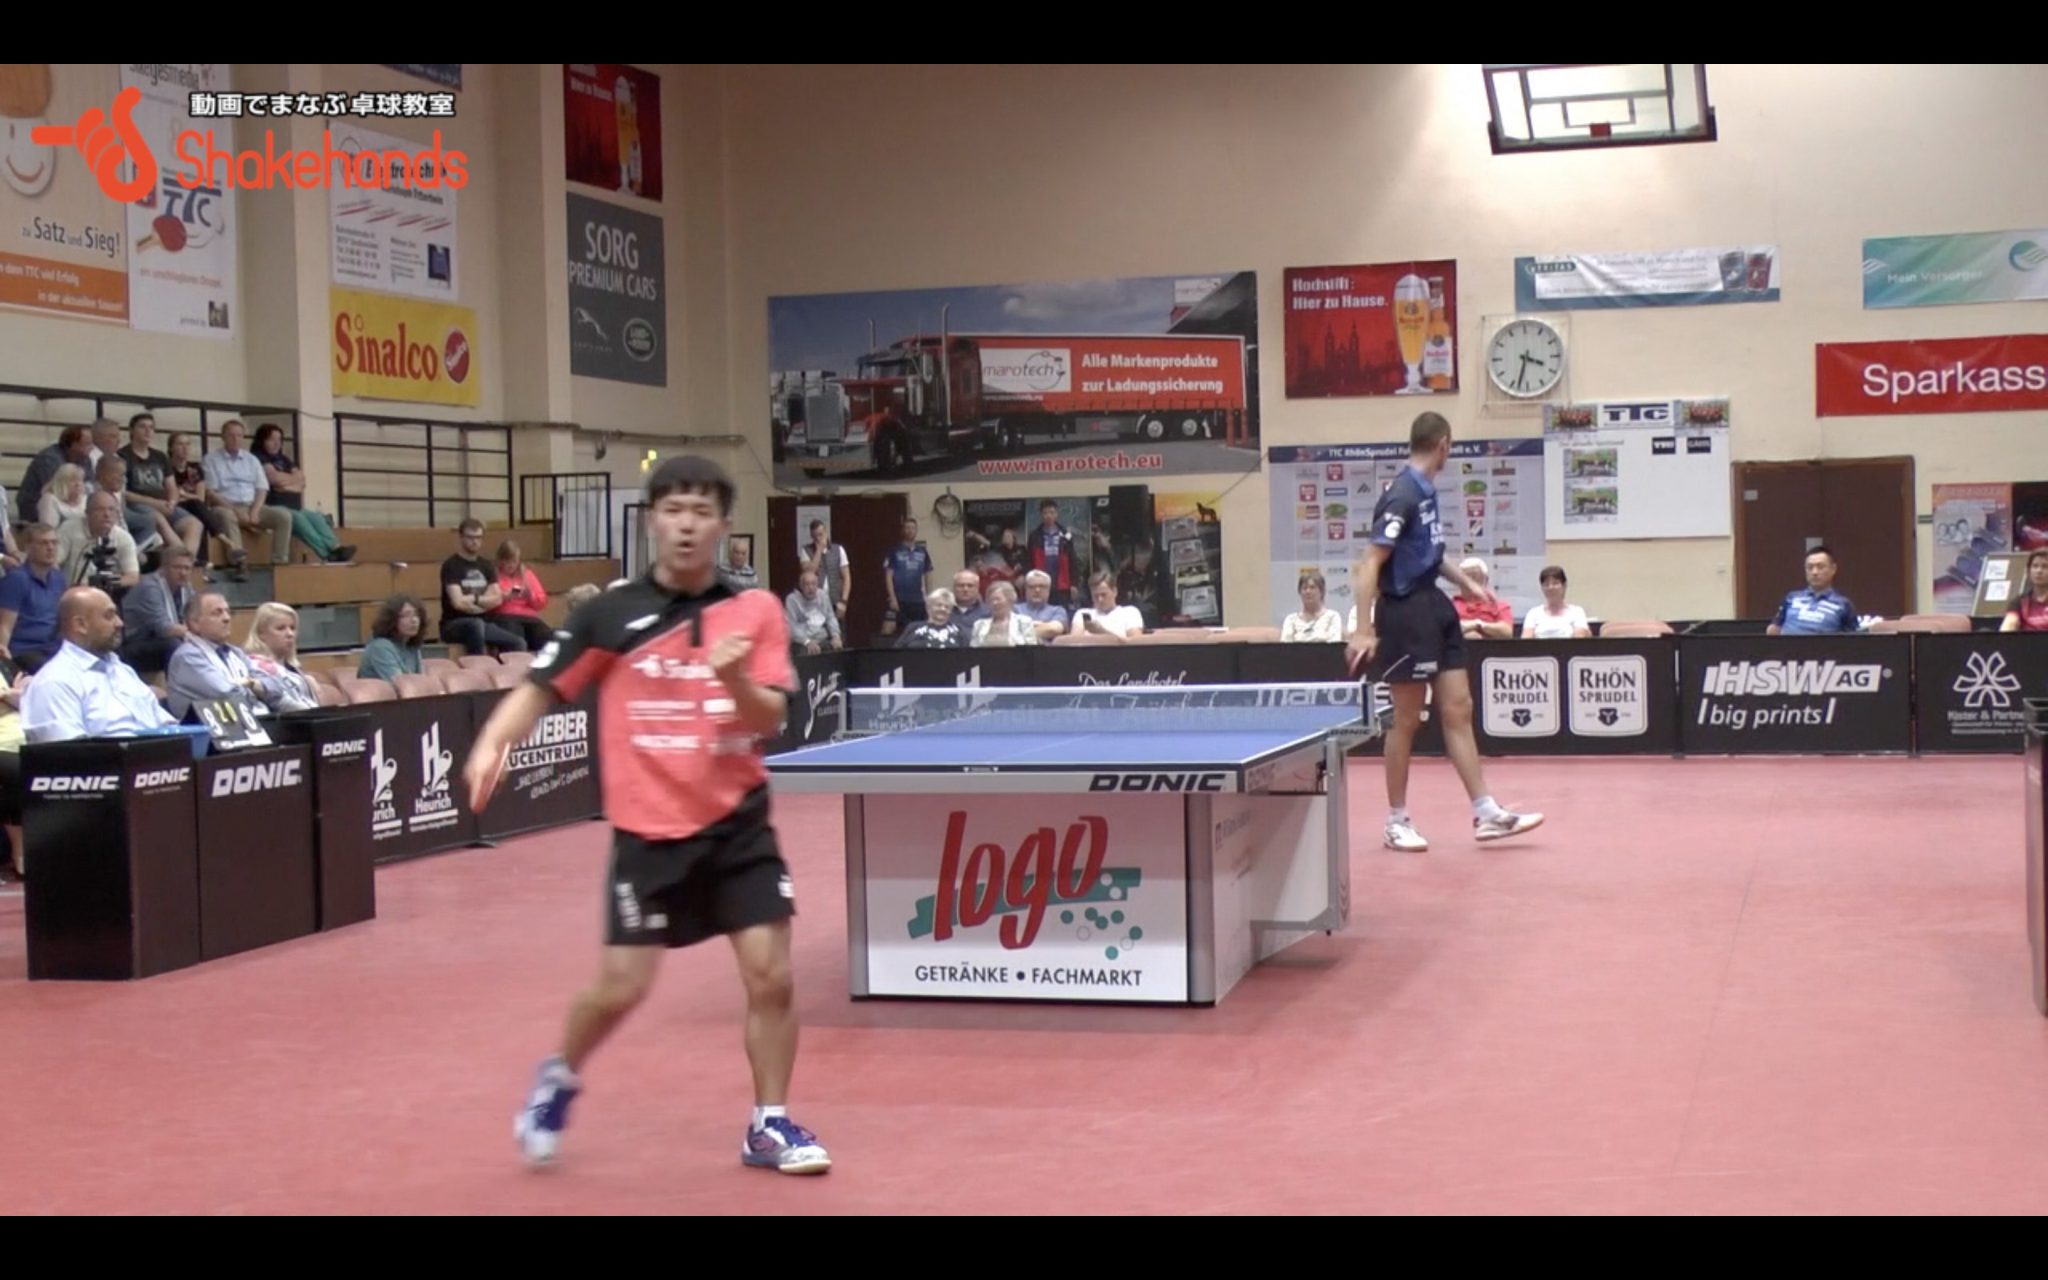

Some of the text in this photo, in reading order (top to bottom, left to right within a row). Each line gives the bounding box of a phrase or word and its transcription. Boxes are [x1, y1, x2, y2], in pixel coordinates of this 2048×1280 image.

[33, 215, 66, 244] Satz
[84, 225, 120, 258] Sieg!
[585, 221, 640, 271] SORG
[569, 260, 657, 301] PREMIUM CARS
[1887, 271, 1984, 283] Mein Versorger
[1292, 296, 1320, 310] Hier
[1324, 298, 1340, 309] zu
[335, 311, 439, 382] Sinalco
[983, 362, 1055, 377] marotech
[1082, 353, 1218, 371] Alle Markenprodukte
[1082, 377, 1223, 395] zur Ladungssicherung
[1863, 361, 2046, 403] Sparkass
[1603, 403, 1669, 422] TTC
[978, 452, 1162, 474] www.marotech.eu
[1328, 449, 1343, 457] TTC
[1493, 669, 1549, 689] RHÖN
[1579, 668, 1636, 688] RHÖN
[1835, 670, 1871, 688] AG
[1492, 691, 1549, 704] SPRUDEL
[1579, 691, 1637, 703] SPRUDEL
[1710, 703, 1822, 729] big prints
[322, 739, 366, 756] DONIC
[31, 776, 120, 792] DONIC
[134, 767, 190, 789] DONIC
[212, 759, 302, 797] DONIC
[1088, 774, 1227, 792] DONIC
[415, 792, 451, 814] Heurich
[934, 811, 1109, 949] logo
[915, 962, 1142, 986] GETRÄNKE FACHMARKT
